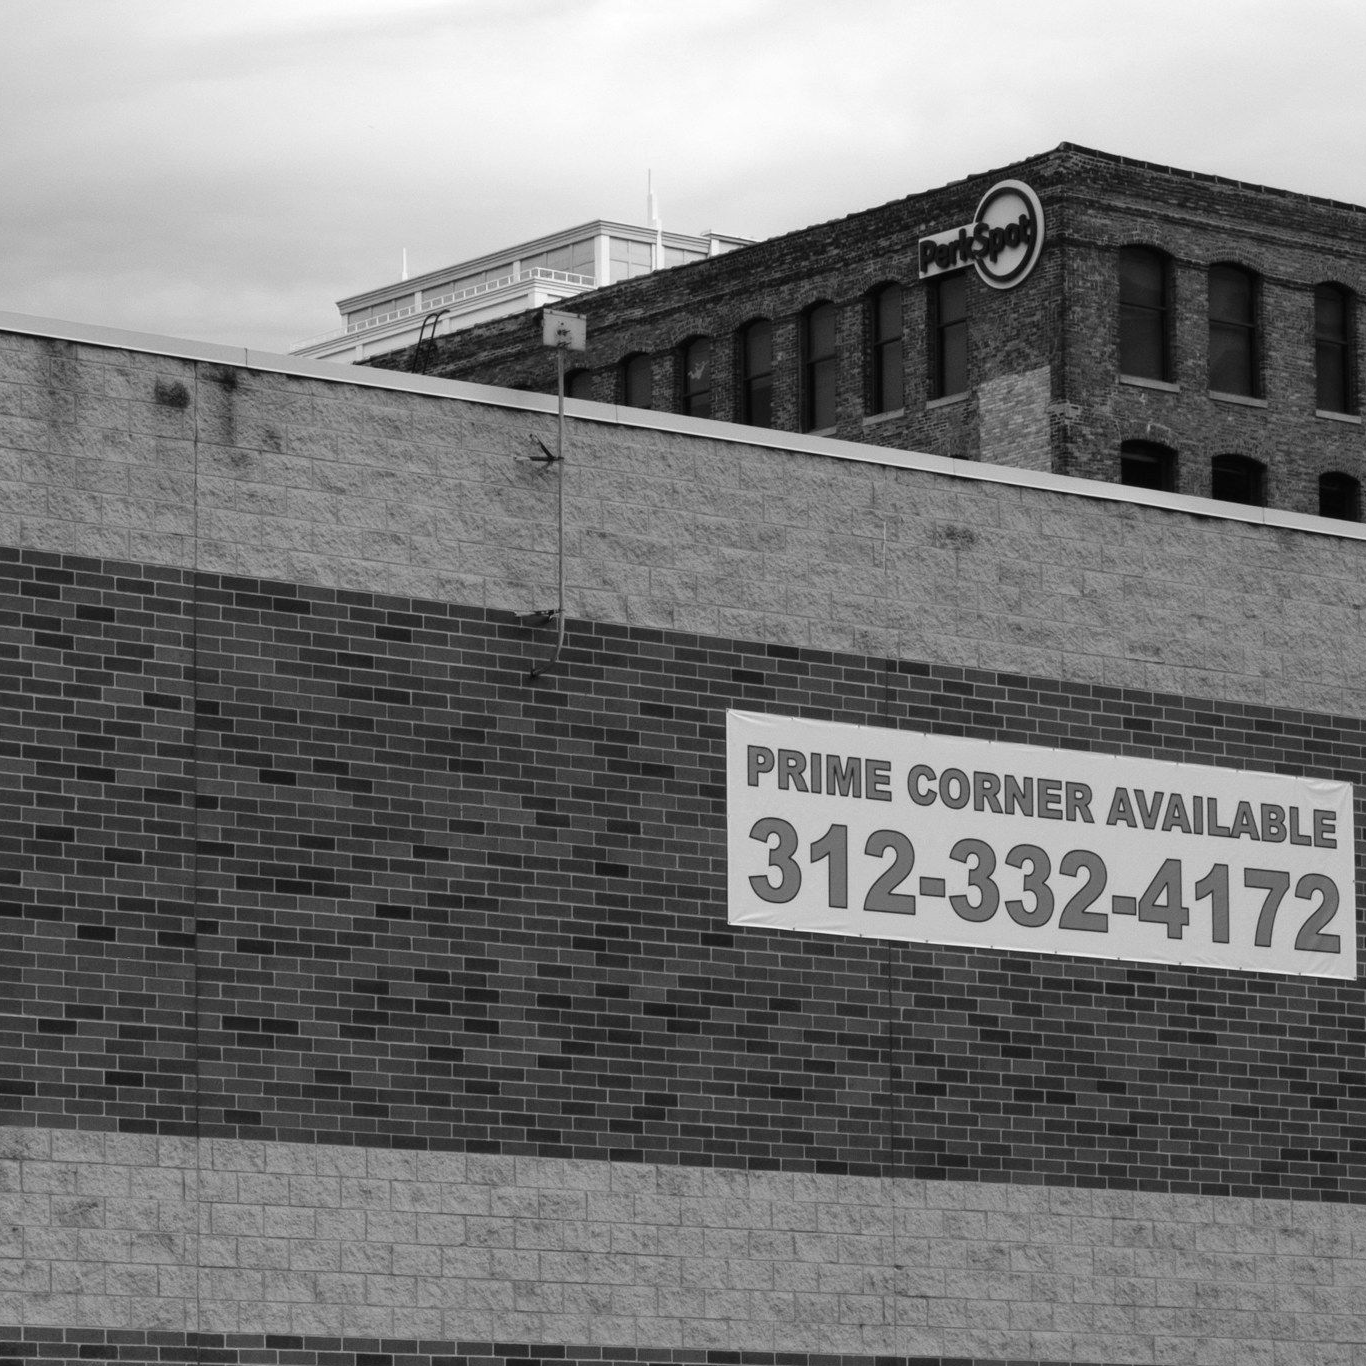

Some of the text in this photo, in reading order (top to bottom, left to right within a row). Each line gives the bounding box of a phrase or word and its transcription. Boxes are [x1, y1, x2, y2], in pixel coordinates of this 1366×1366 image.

[920, 214, 1030, 274] PerkSpot
[746, 744, 1338, 849] PRIME CORNER AVAILABLE
[748, 816, 1341, 954] 312-332-4172
